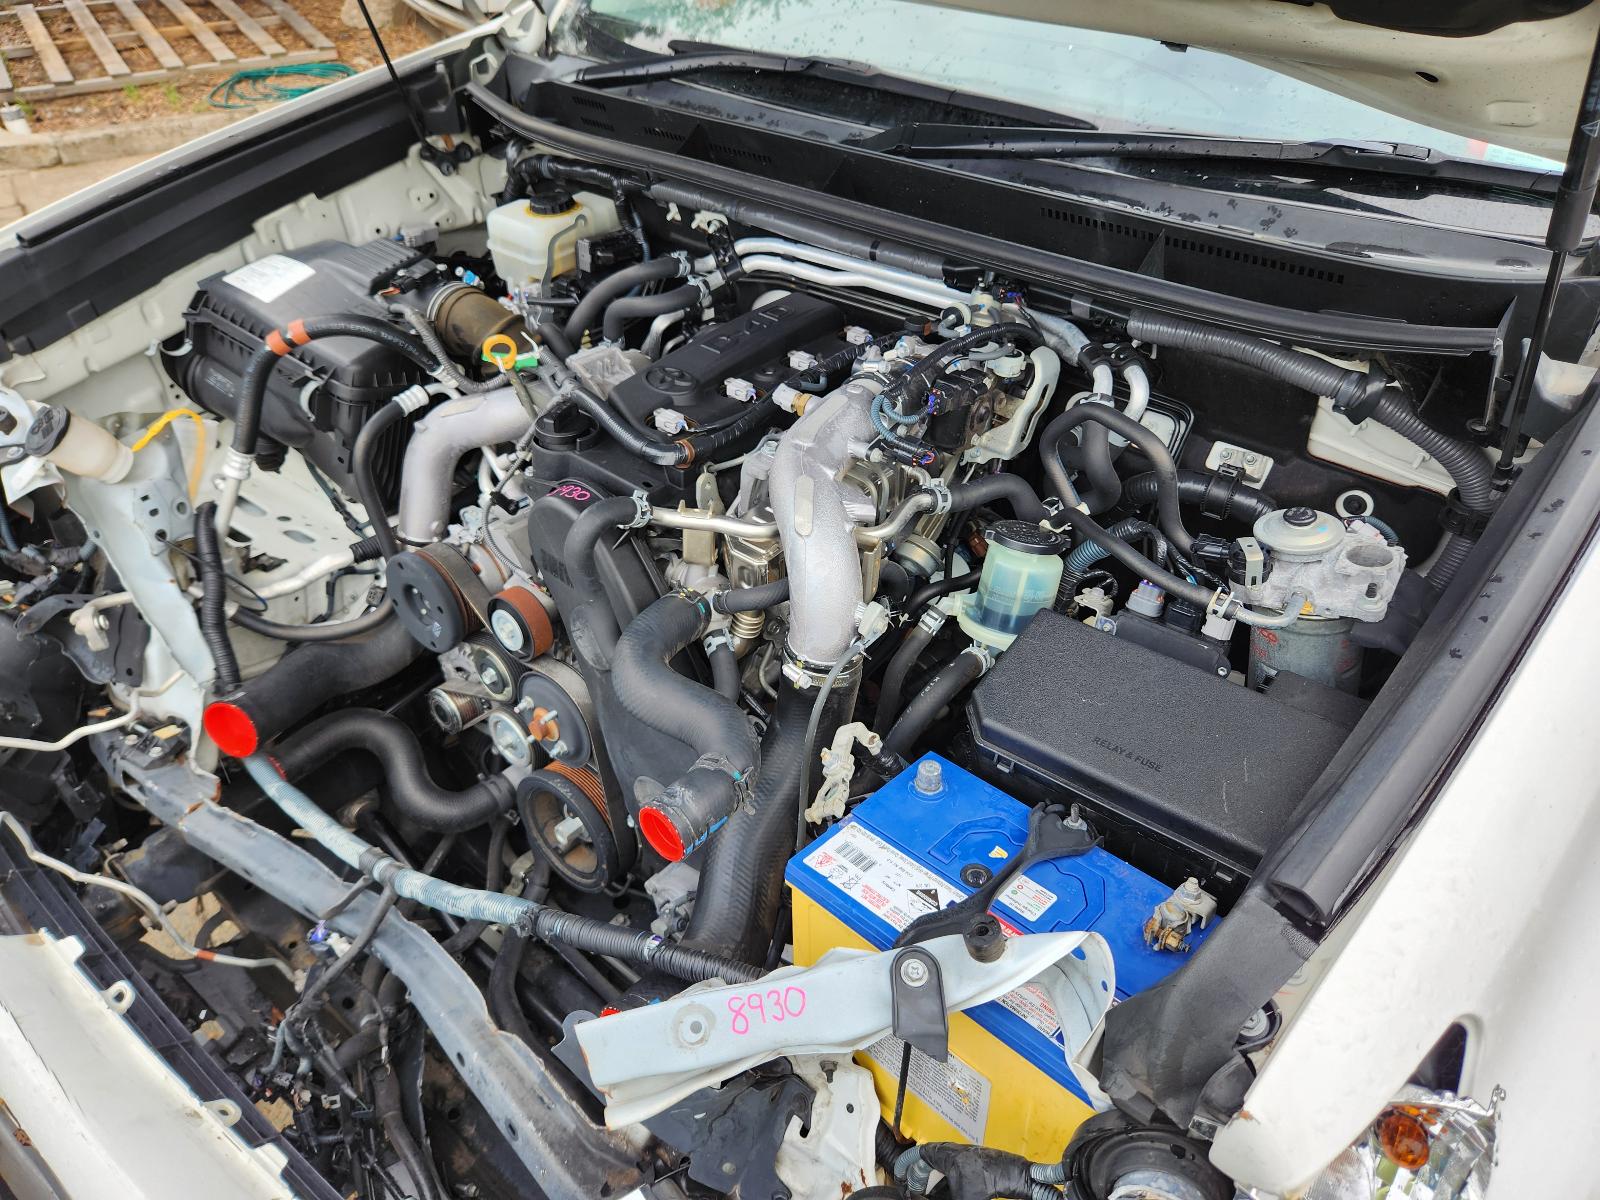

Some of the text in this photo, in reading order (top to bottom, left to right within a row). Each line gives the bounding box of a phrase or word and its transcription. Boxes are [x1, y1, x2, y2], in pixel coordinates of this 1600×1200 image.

[1092, 736, 1126, 754] RELAY
[1134, 755, 1162, 773] FUSE
[727, 986, 806, 1035] 8930
